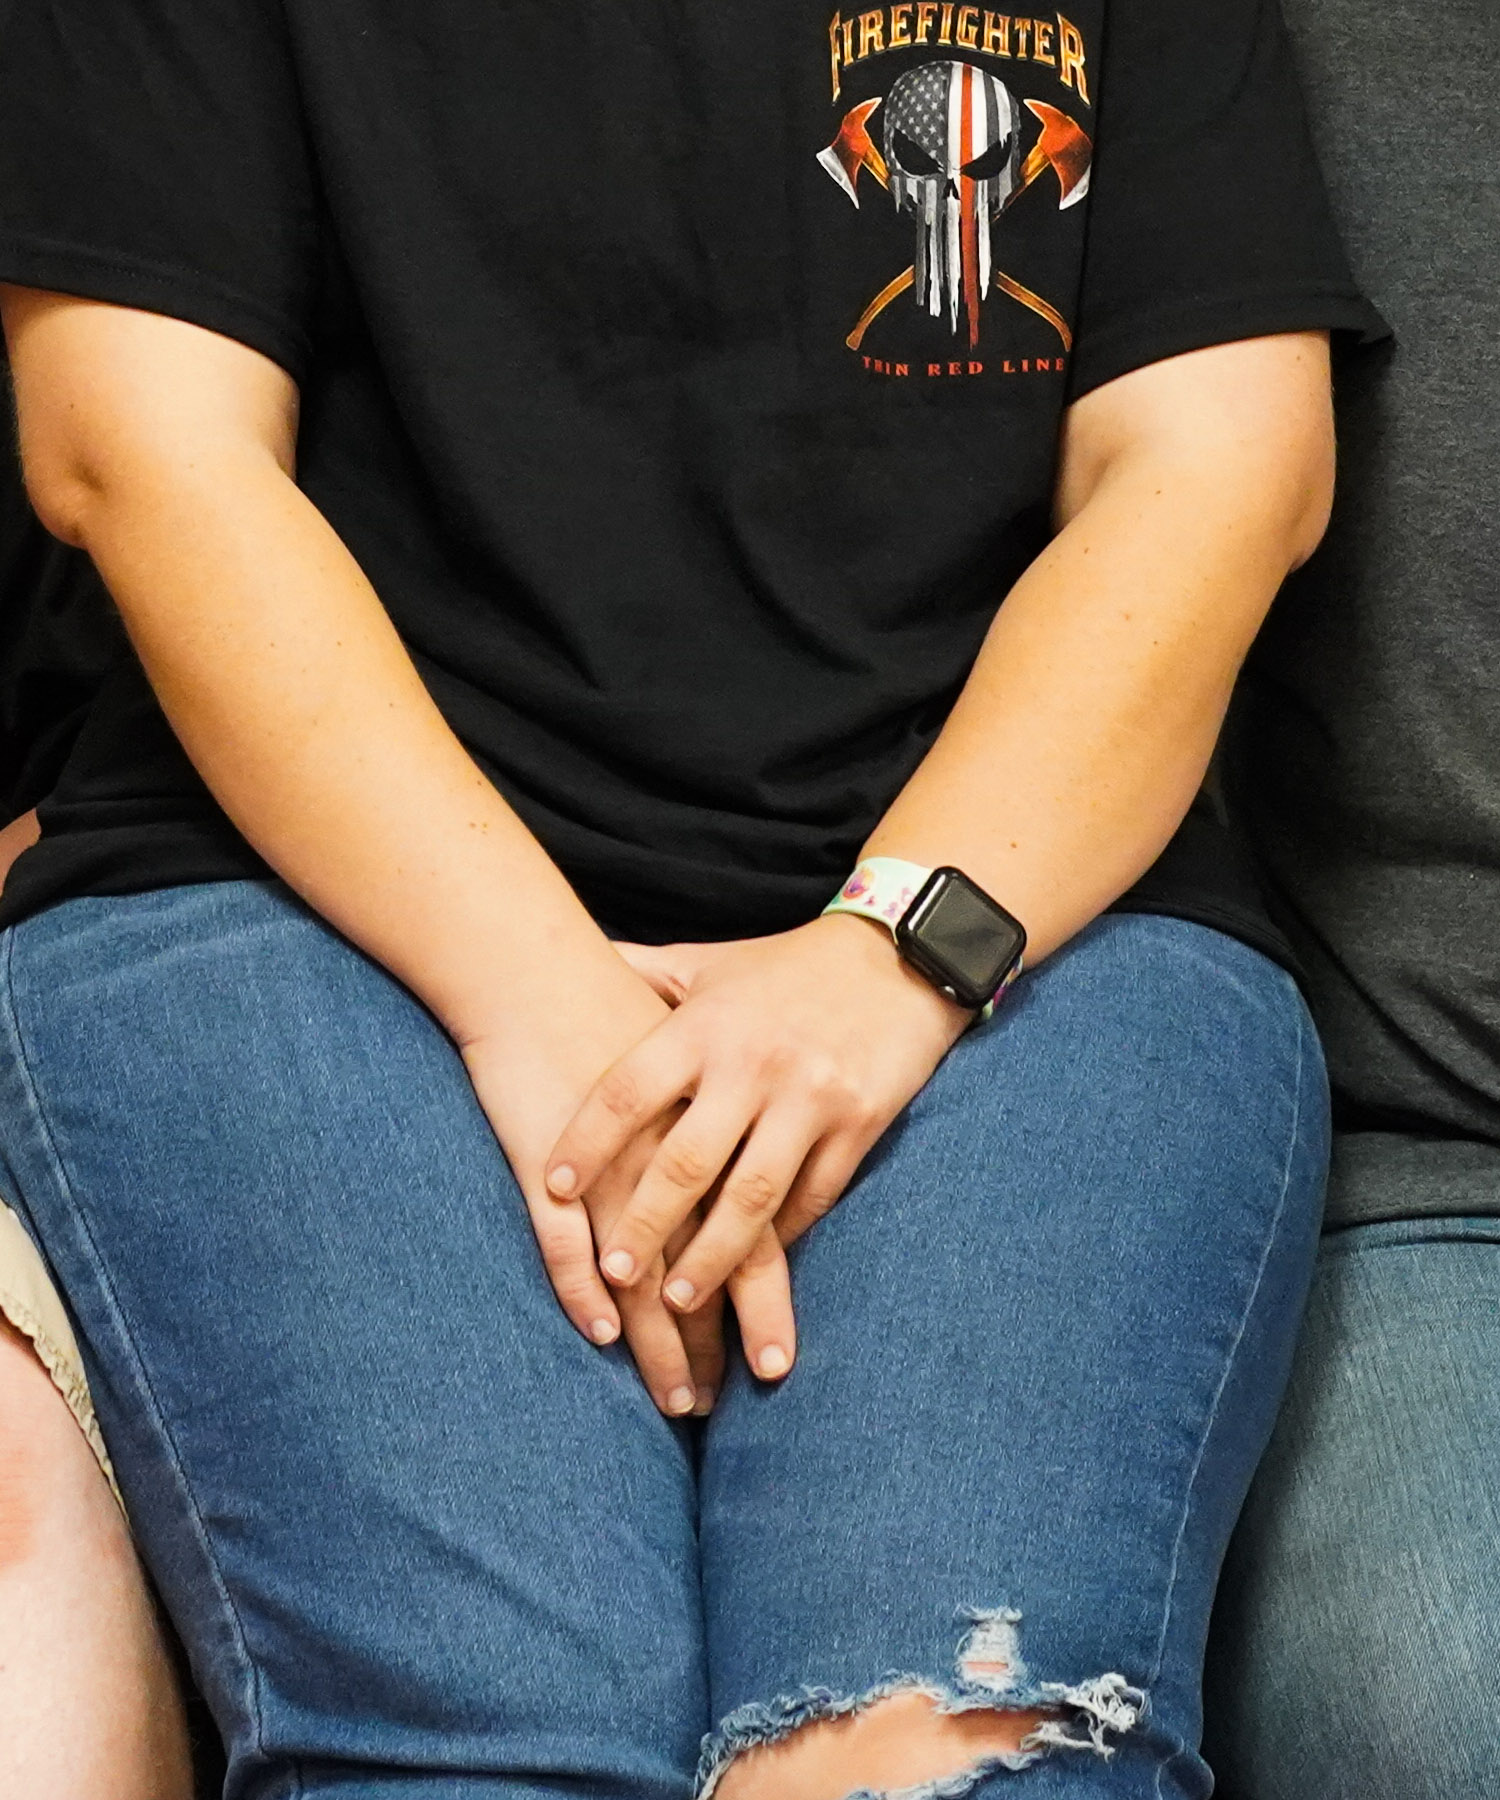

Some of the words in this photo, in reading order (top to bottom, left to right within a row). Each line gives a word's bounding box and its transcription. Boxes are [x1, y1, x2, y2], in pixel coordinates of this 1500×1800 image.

[828, 1, 1091, 106] FIREFIGHTER
[863, 355, 910, 377] THIN
[927, 360, 984, 377] RED
[1003, 357, 1065, 374] LINE
